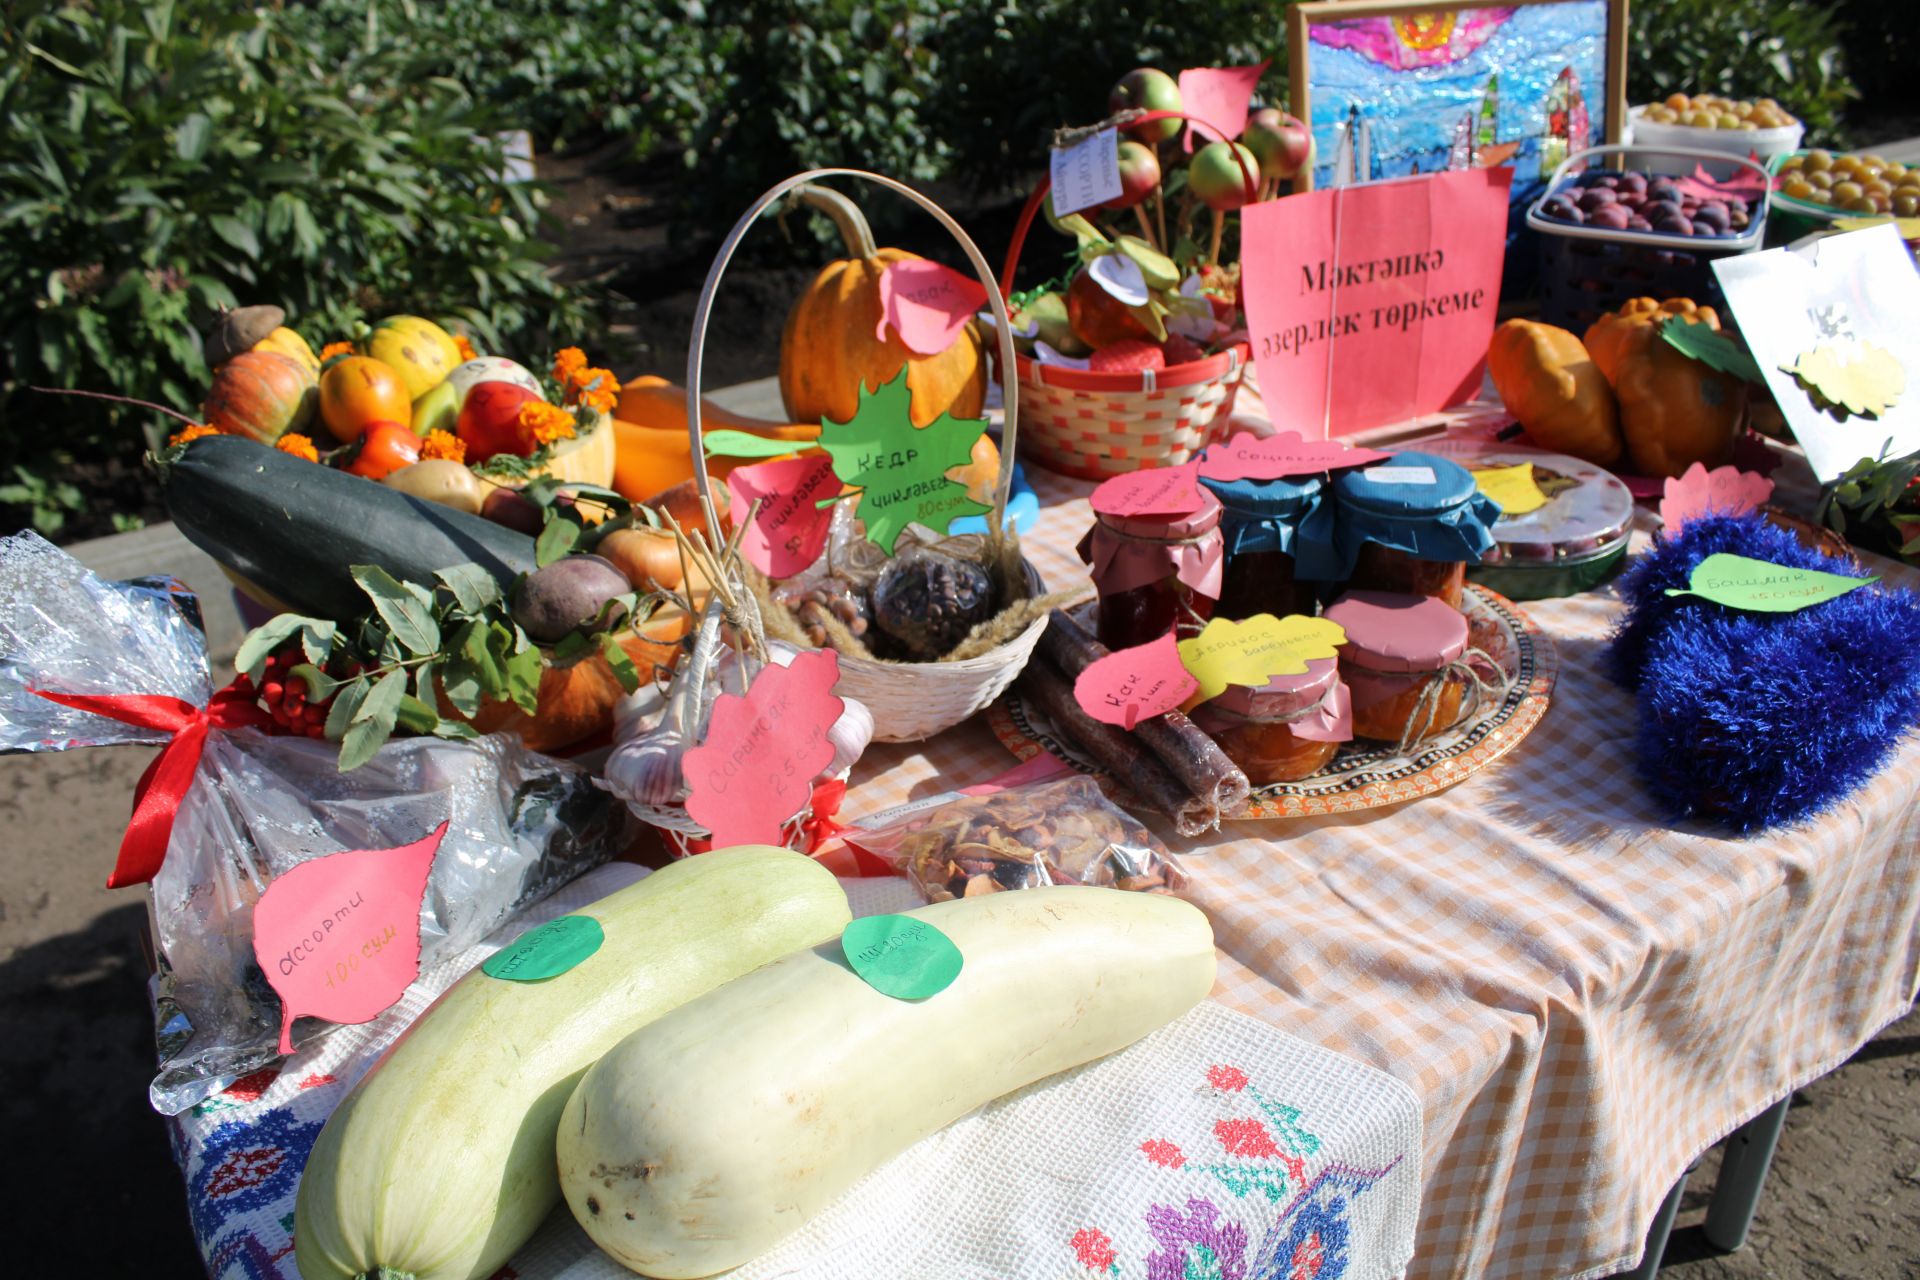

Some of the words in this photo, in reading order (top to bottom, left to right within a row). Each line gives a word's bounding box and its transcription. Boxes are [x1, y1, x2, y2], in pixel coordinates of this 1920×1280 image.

[1300, 249, 1444, 296] Мәктәпкә
[1262, 311, 1361, 358] әзерлек
[1369, 287, 1484, 333] төркеме
